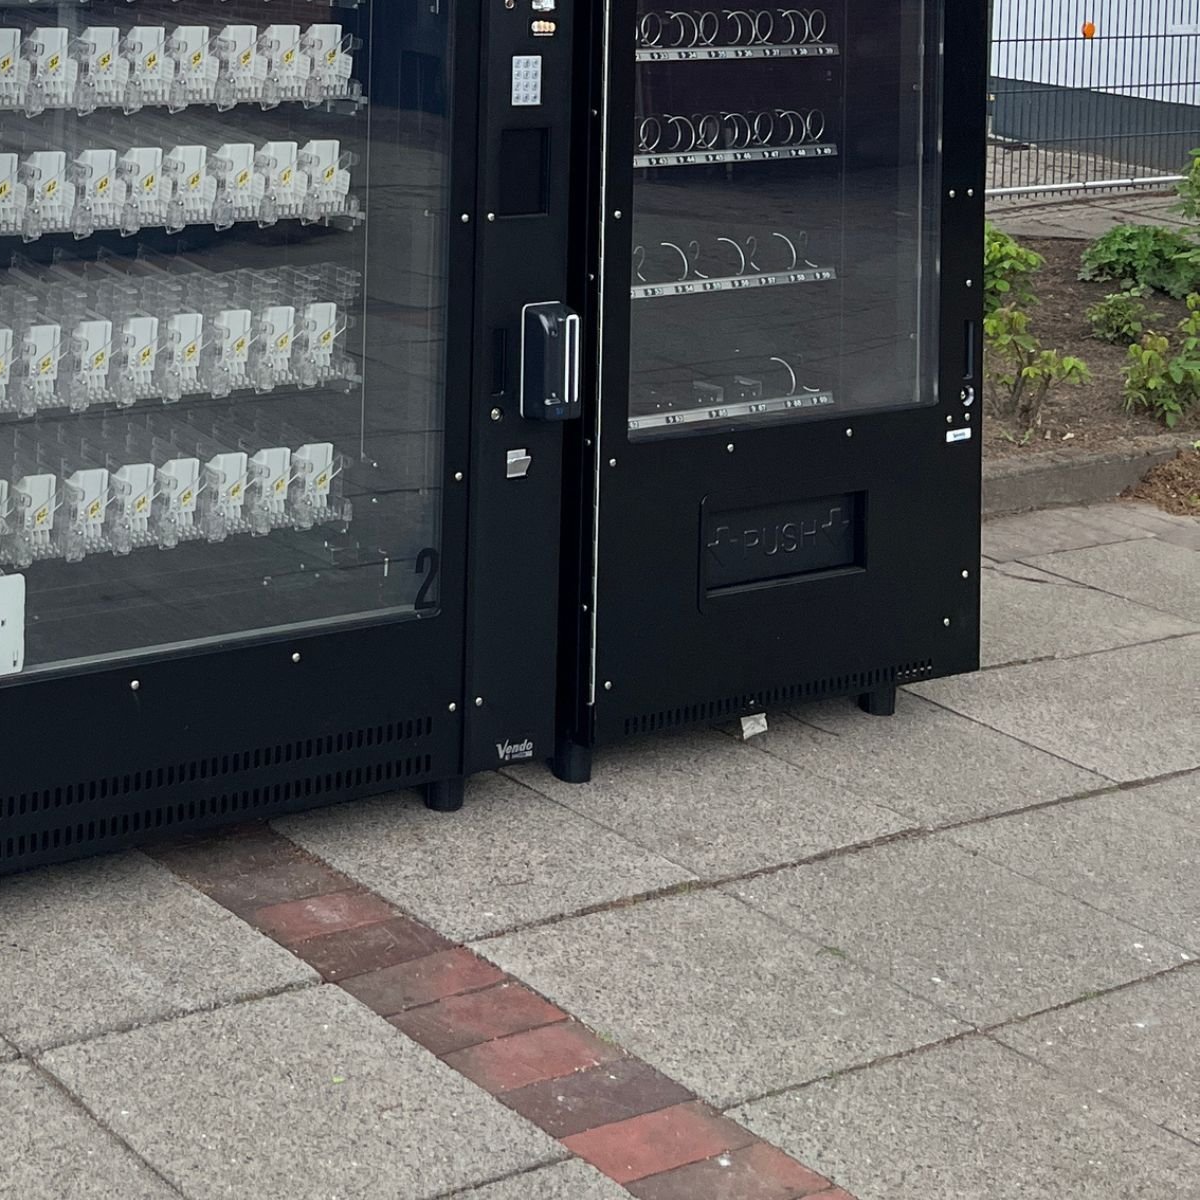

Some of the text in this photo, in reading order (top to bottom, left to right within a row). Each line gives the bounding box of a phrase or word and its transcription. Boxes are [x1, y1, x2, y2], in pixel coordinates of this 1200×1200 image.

[744, 519, 817, 555] PUSH
[415, 548, 440, 610] 2
[496, 739, 533, 759] Vendo
